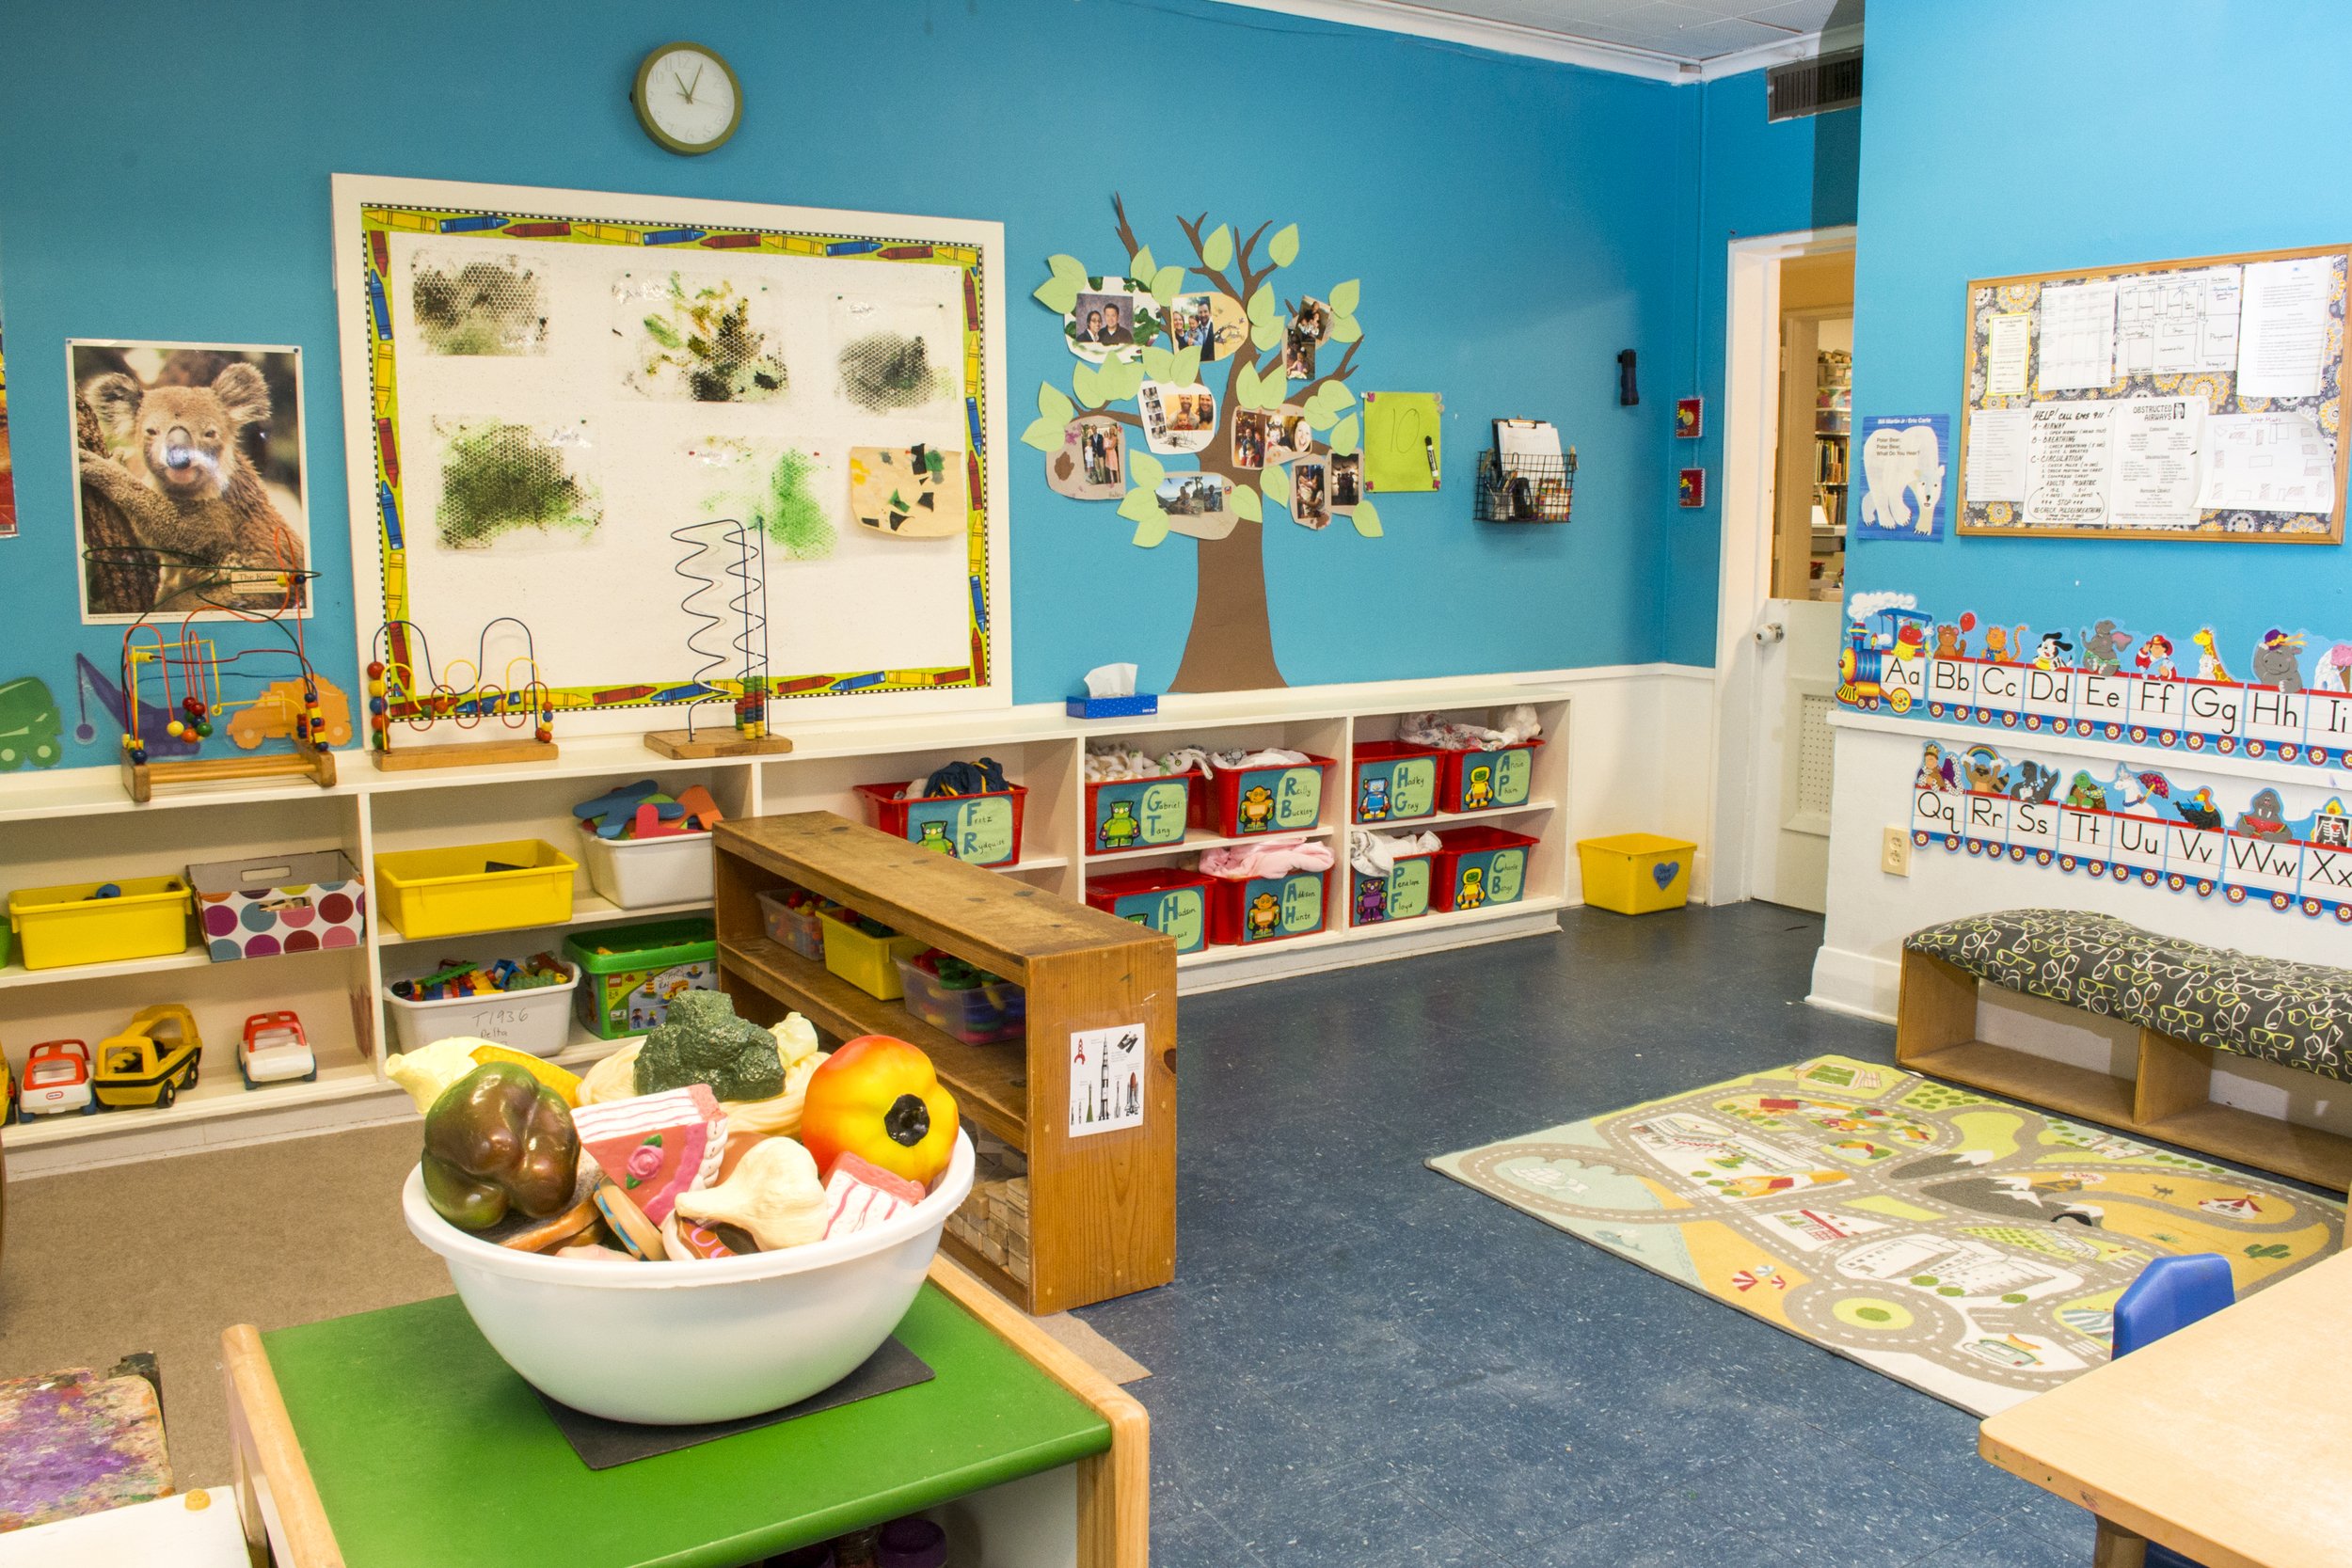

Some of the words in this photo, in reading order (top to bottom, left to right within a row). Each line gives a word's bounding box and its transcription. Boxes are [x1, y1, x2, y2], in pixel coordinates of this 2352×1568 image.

[2032, 407, 2059, 420] HELP!
[2058, 412, 2073, 420] CALL
[2133, 405, 2173, 414] OBSTRUCTED
[2144, 413, 2173, 421] AIRWAYS
[1390, 407, 1421, 453] 10
[1885, 657, 1919, 685] Aa
[1936, 661, 1970, 690] Bb
[1982, 667, 2016, 696] Cc
[2030, 672, 2069, 703] Dd
[2087, 676, 2120, 707] Ee
[2141, 682, 2175, 713] Ff
[2192, 688, 2236, 734] Gg
[2253, 692, 2297, 727] Hh
[2328, 700, 2347, 733] Ii
[1147, 790, 1181, 812] Gabriel
[1280, 800, 1313, 818] Buckley
[1147, 815, 1170, 837] Tang
[1917, 791, 1961, 833] Qq
[1972, 798, 2003, 827] Rr
[2017, 804, 2048, 833] Ss
[2070, 813, 2100, 844] Tt
[2122, 820, 2157, 854] Uu
[2179, 830, 2213, 863] Vv
[2231, 838, 2296, 877] Ww
[2309, 850, 2352, 887] Xx
[481, 1027, 509, 1039] Delta
